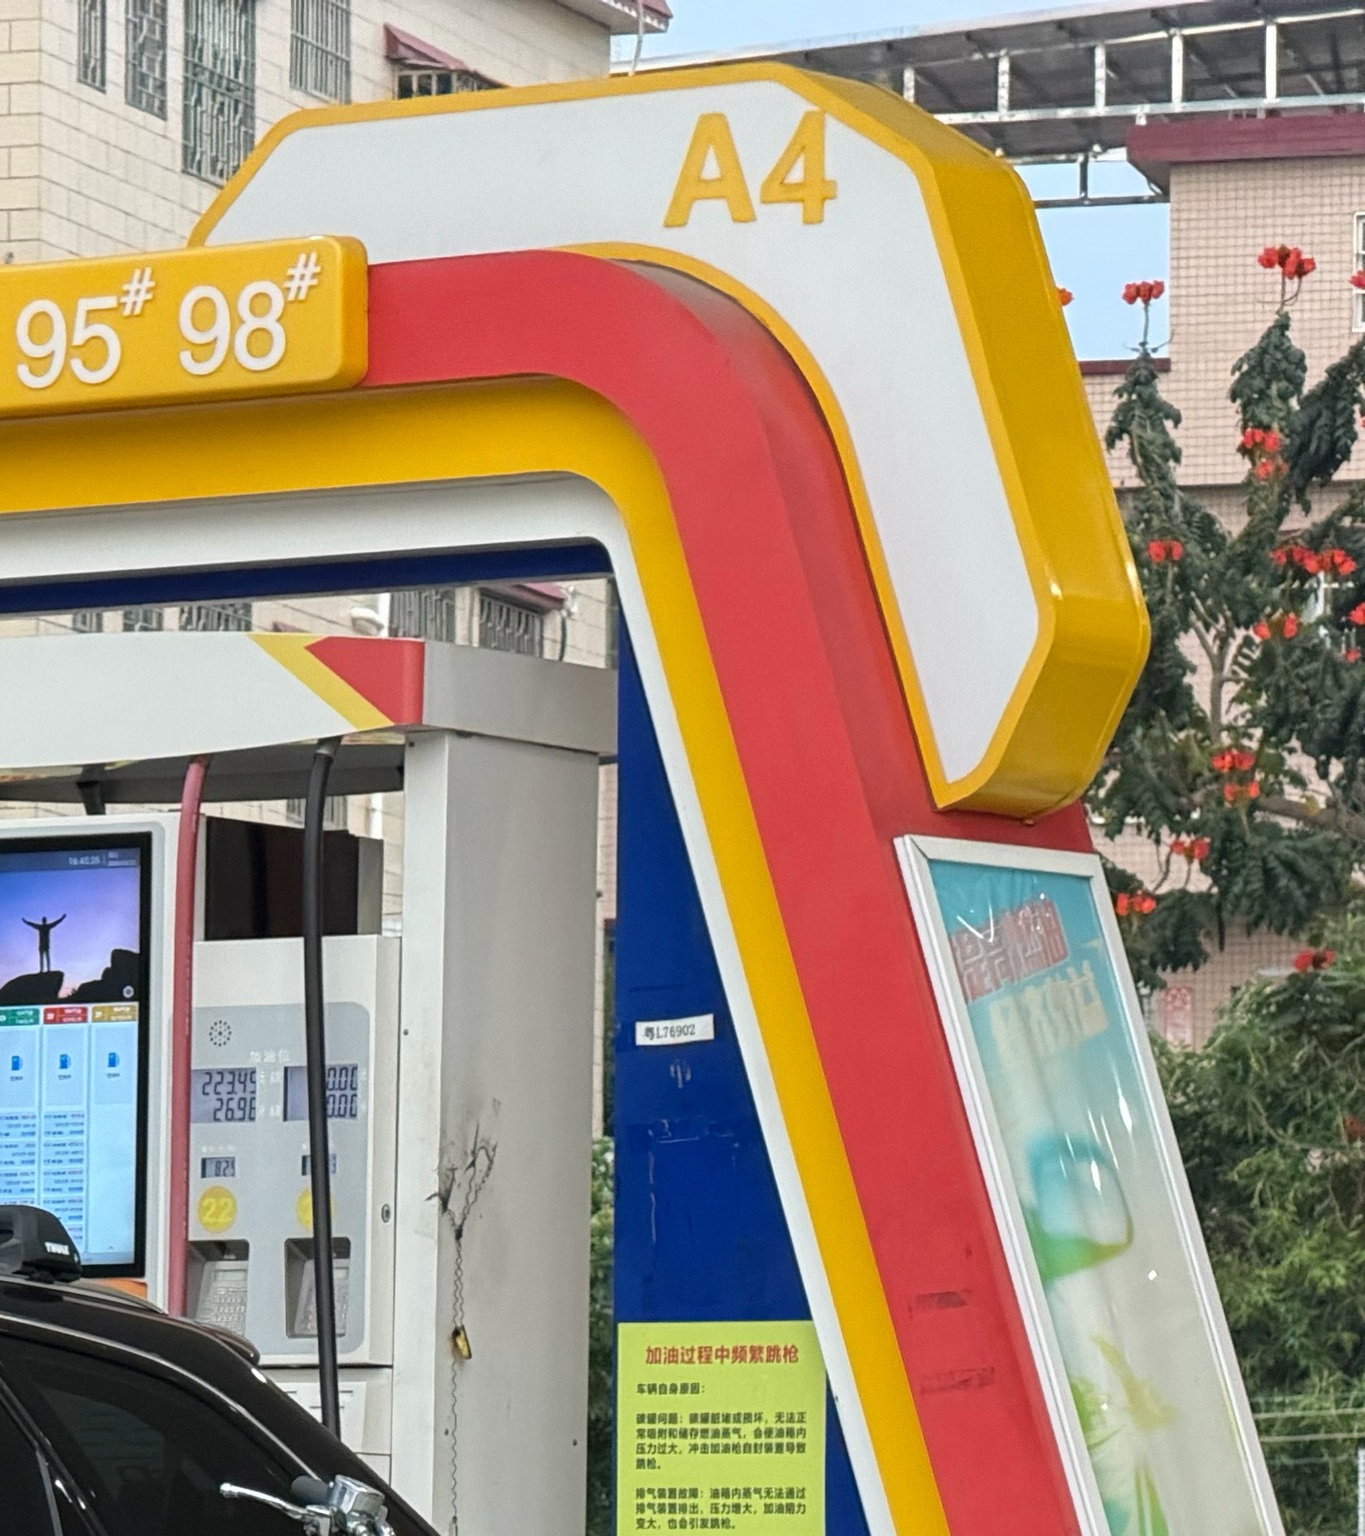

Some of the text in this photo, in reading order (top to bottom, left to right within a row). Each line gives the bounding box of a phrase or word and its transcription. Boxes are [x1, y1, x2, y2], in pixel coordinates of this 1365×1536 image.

[662, 110, 838, 228] A4
[15, 266, 156, 389] 95#
[179, 252, 322, 376] 98#
[646, 1345, 799, 1364] 加油过程中频繁跳枪
